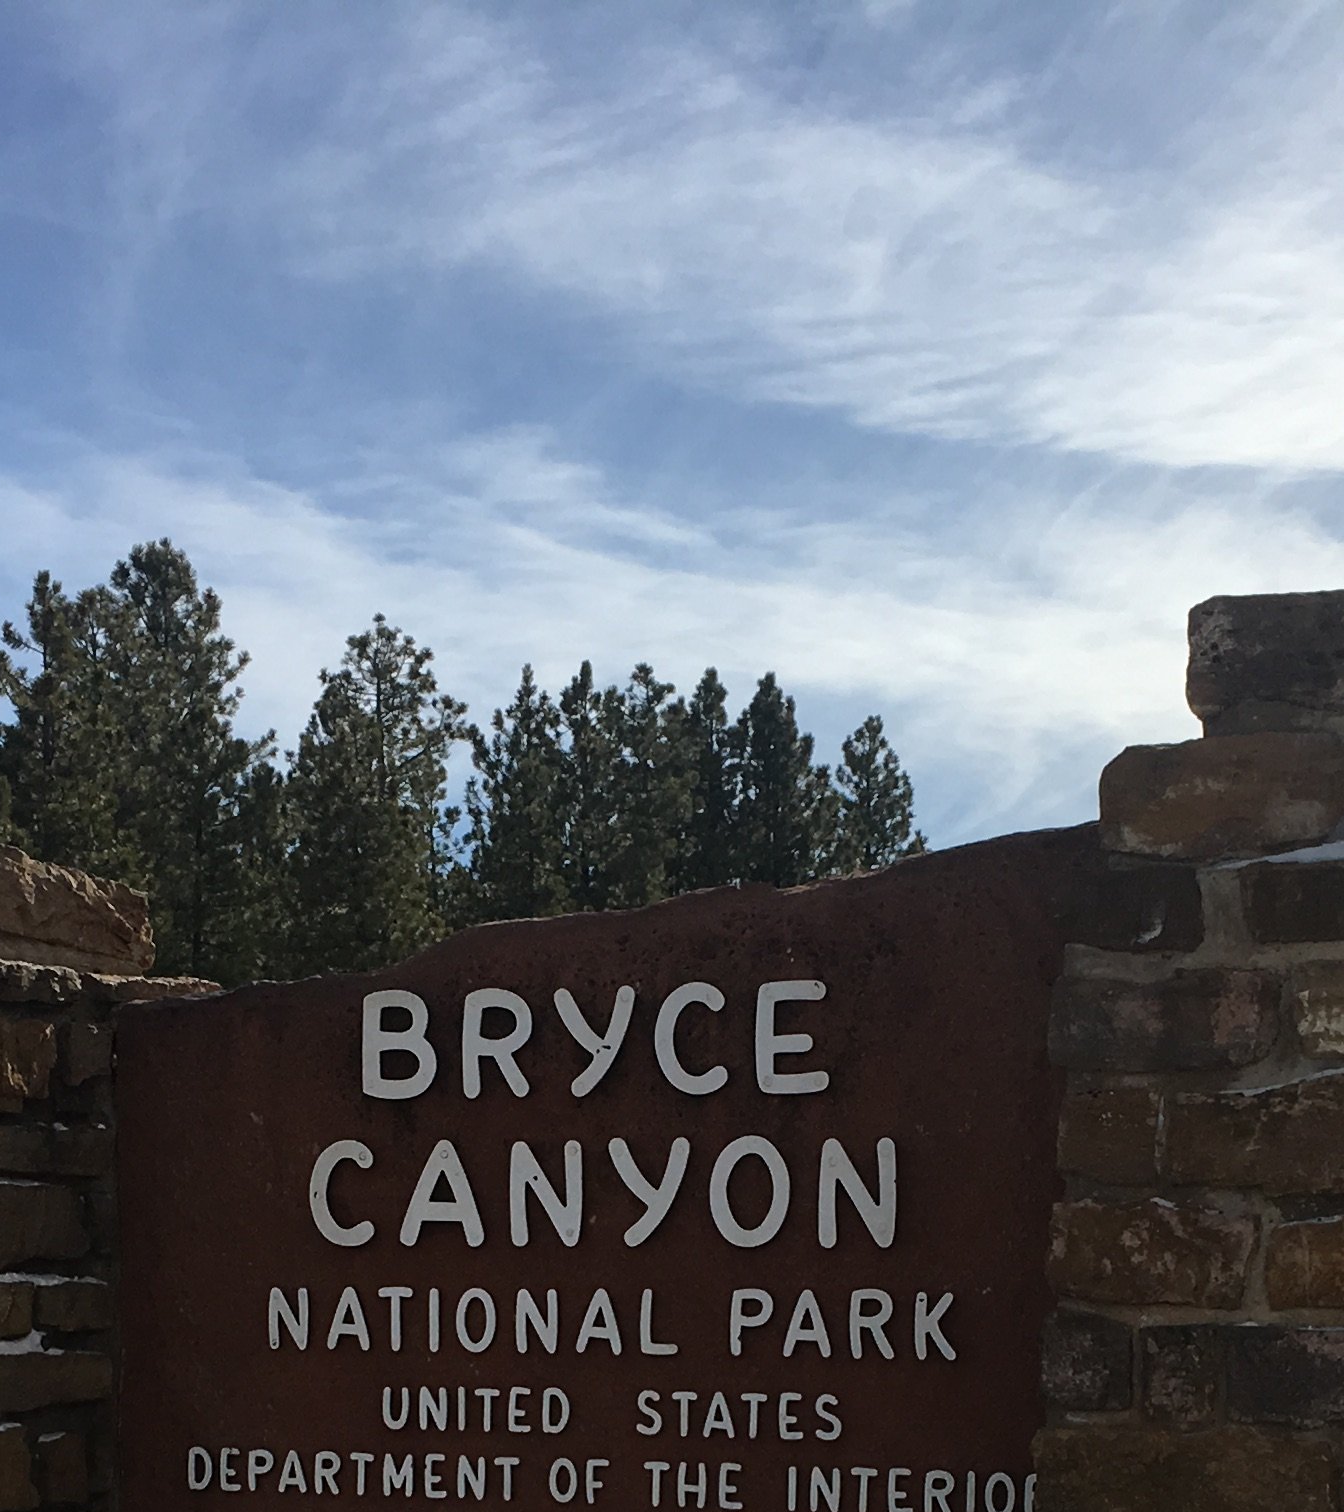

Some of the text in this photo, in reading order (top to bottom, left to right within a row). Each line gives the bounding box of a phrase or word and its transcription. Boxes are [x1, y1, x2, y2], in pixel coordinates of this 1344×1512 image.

[361, 979, 830, 1100] BRYCE
[309, 1135, 897, 1249] CANYON
[268, 1286, 957, 1361] NATIONAL PARK
[382, 1385, 842, 1441] UNITED STATES
[187, 1446, 520, 1502] DEPARTMENT
[548, 1457, 610, 1504] OF
[643, 1461, 743, 1510] THE
